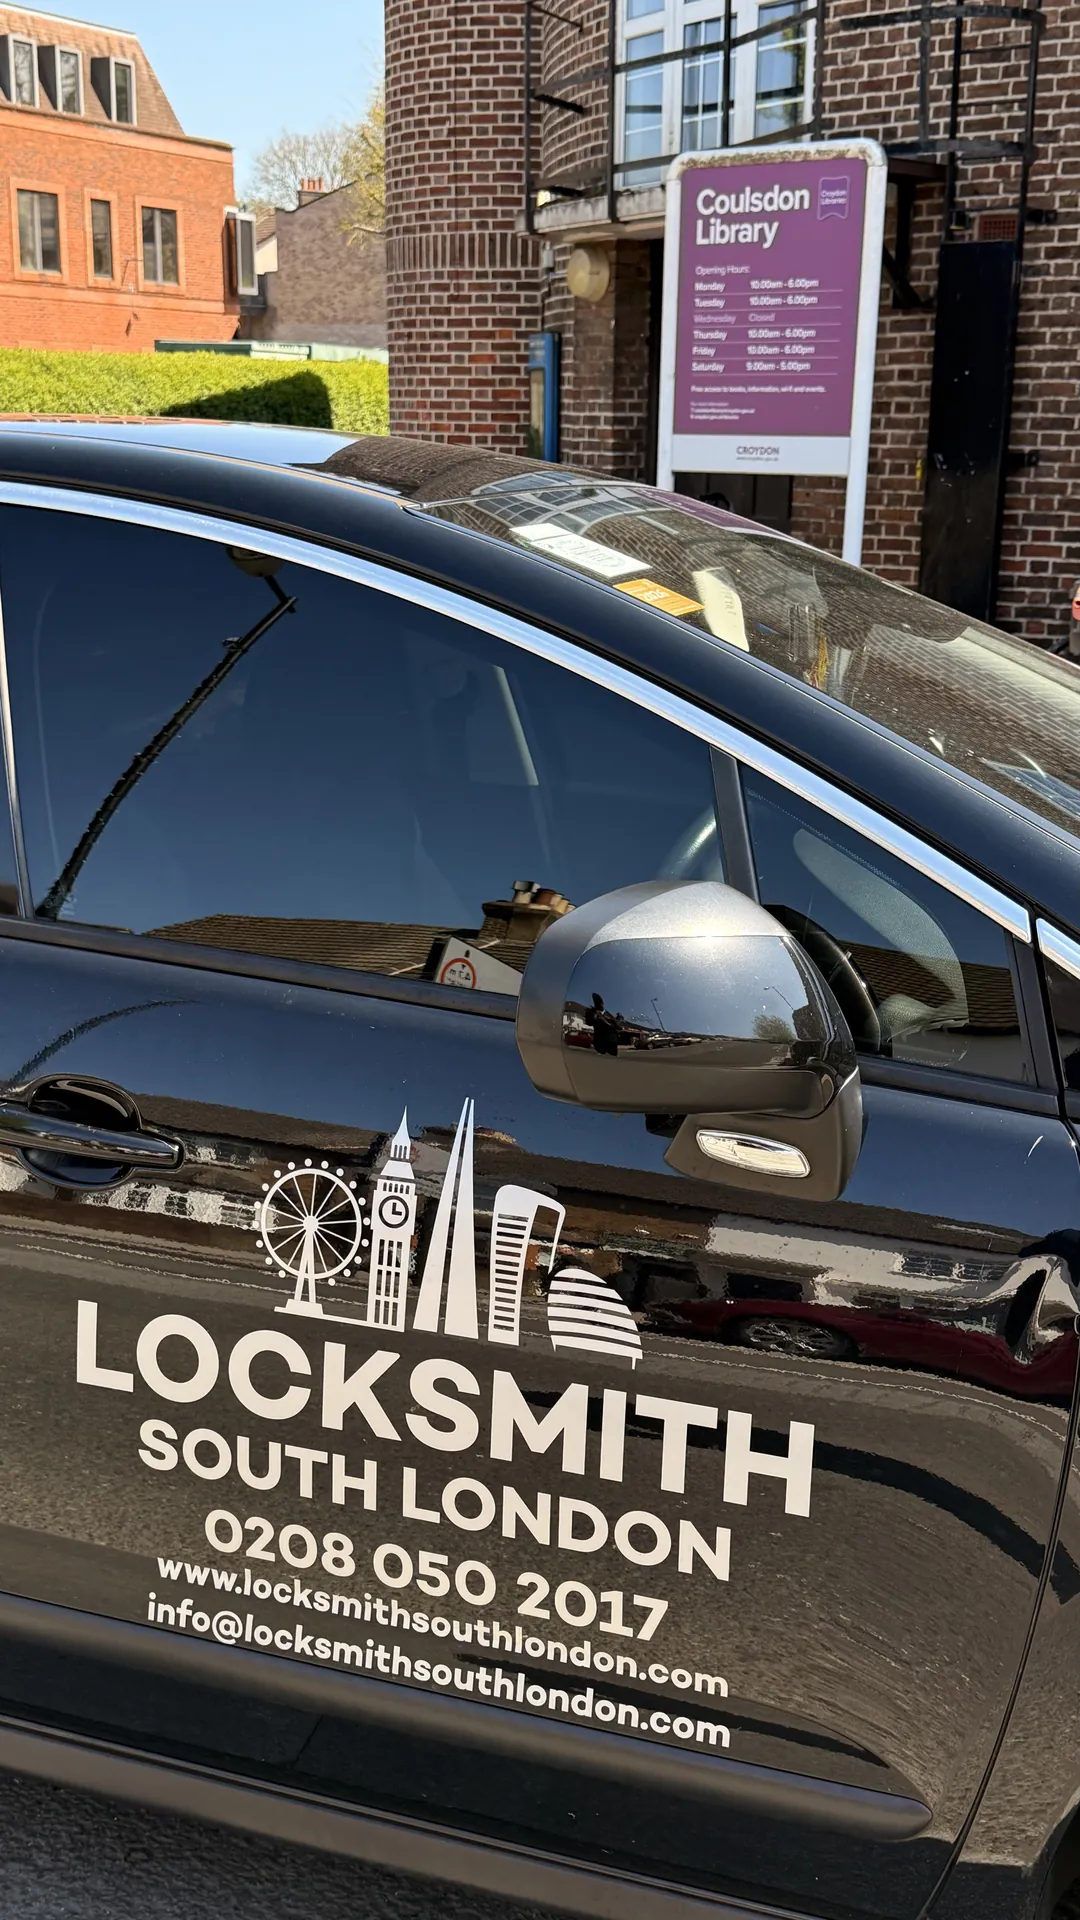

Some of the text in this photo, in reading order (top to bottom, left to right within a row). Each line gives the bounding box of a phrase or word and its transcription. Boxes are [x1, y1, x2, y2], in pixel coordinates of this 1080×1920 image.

[696, 184, 810, 216] Coulsdon
[695, 218, 779, 249] Library
[695, 264, 750, 276] Opening Hours:
[695, 281, 725, 292] Monday
[694, 298, 725, 308] Tuesday
[693, 312, 775, 324] Wednesday Closed
[693, 330, 727, 341] Thursday
[692, 346, 716, 357] Friday
[691, 361, 725, 373] Saturday
[736, 446, 780, 455] CROYDON
[76, 1300, 815, 1518] LOCKSMITH
[138, 1418, 732, 1582] SOUTH LONDON
[204, 1508, 669, 1642] 0208 050 2017
[156, 1555, 730, 1699] www.locksmithsouthlondon.com
[147, 1592, 731, 1749] info@locksmithsouthlondon.com
